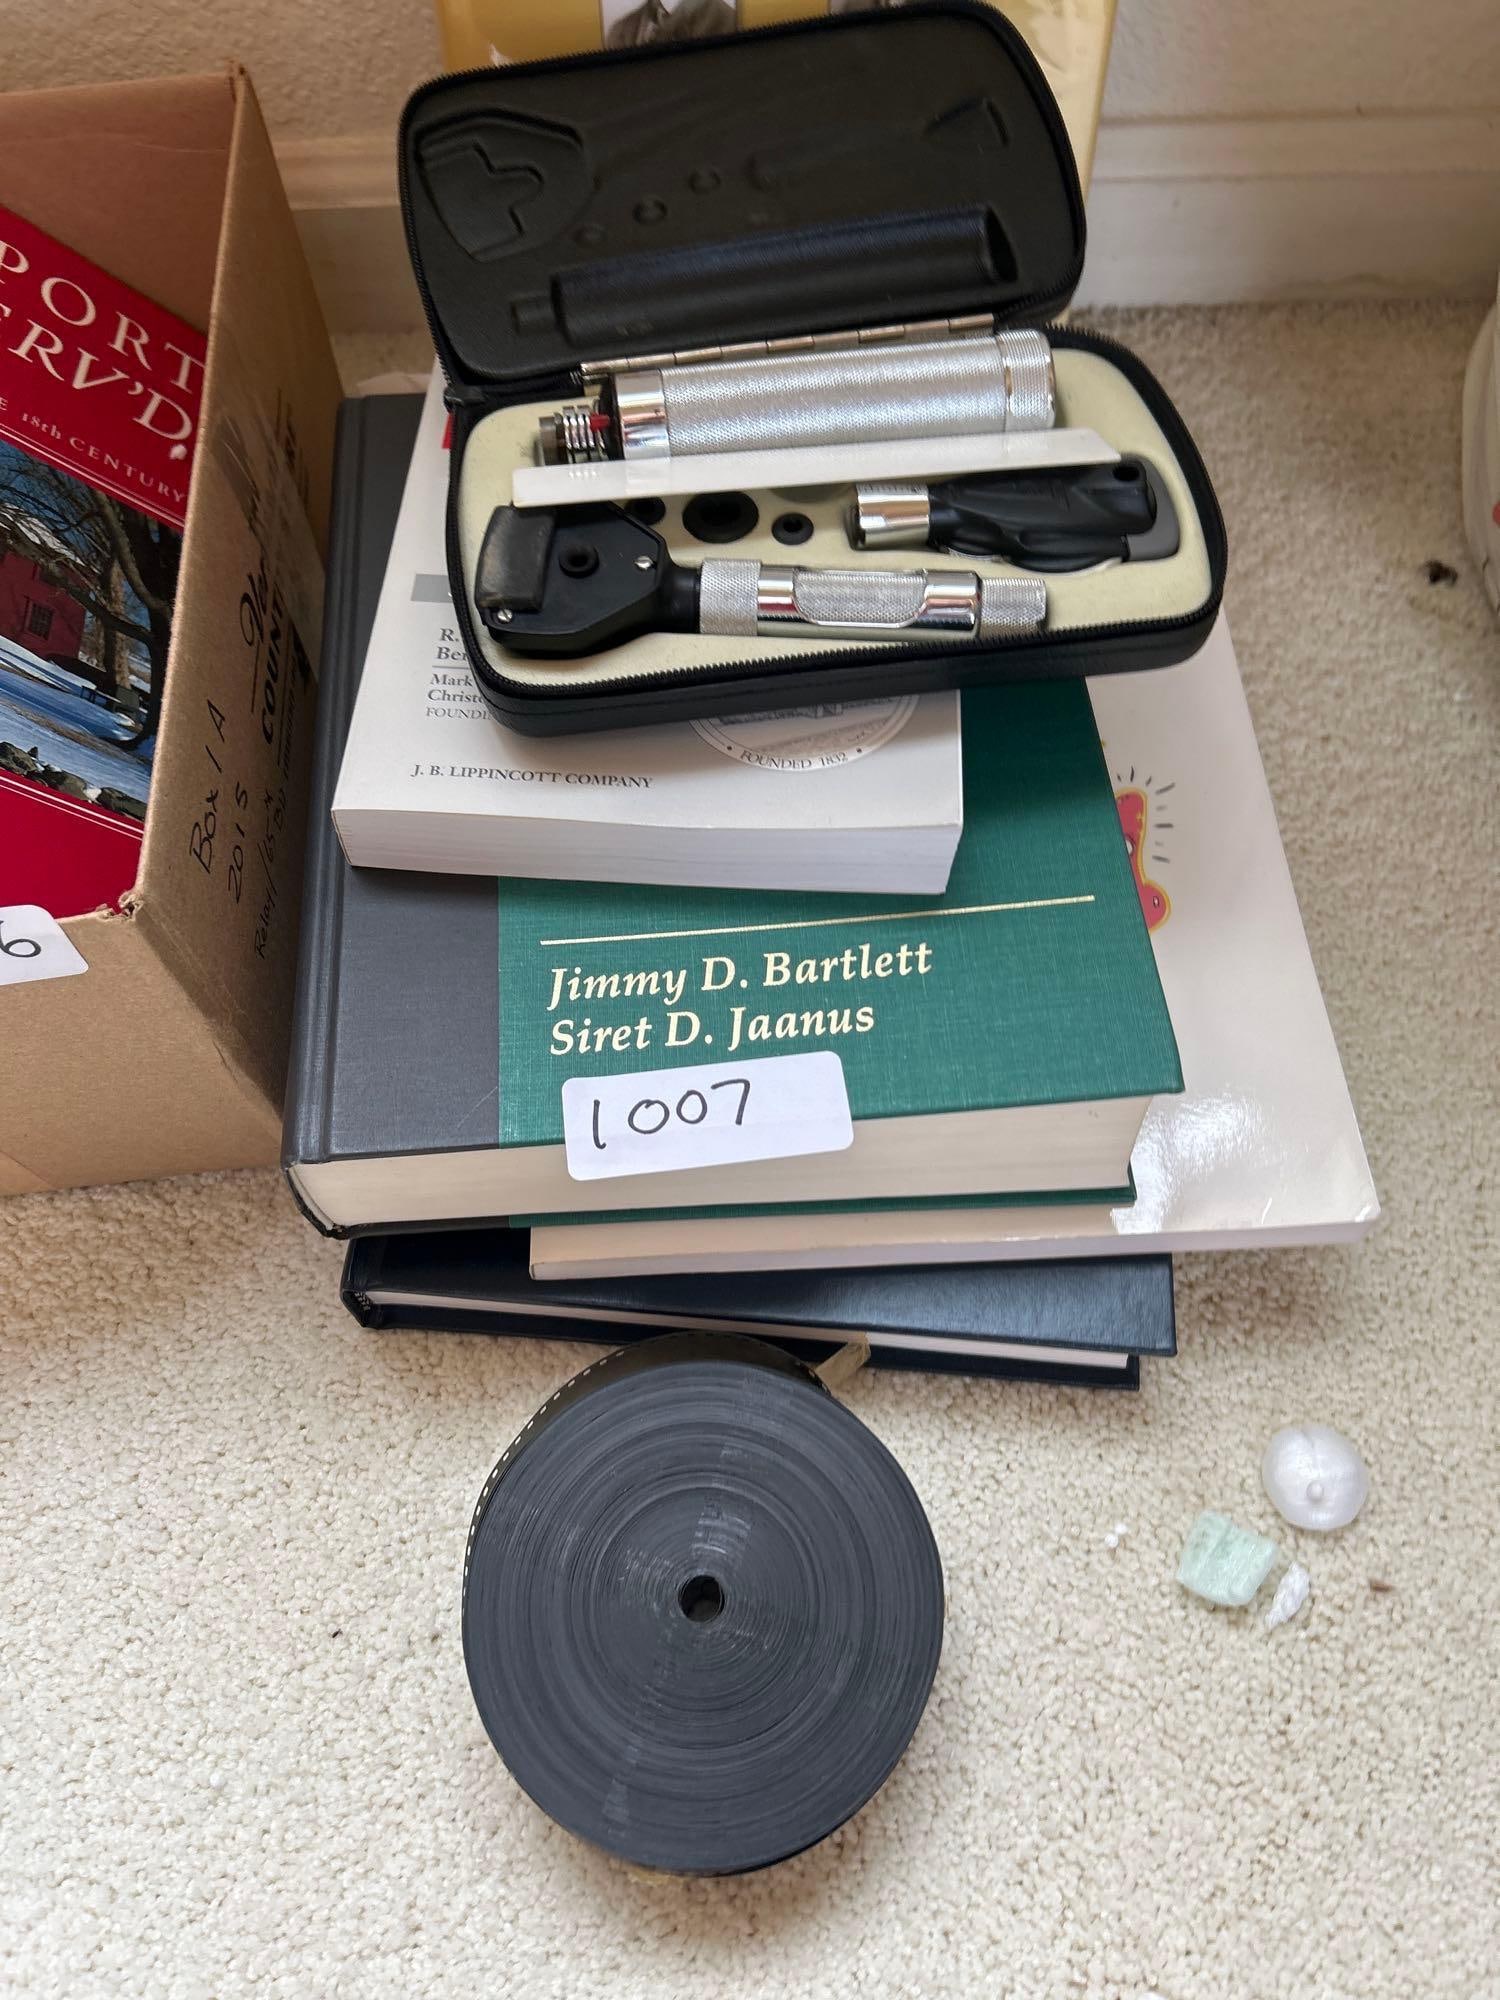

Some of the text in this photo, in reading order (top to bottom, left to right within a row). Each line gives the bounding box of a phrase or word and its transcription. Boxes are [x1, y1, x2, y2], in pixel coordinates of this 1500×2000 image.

[0, 303, 193, 460] RV'D.
[69, 437, 188, 503] CENTURY
[439, 628, 459, 642] R.
[430, 673, 473, 687] Mark
[189, 788, 219, 873] Box
[207, 699, 226, 743] A
[411, 764, 653, 788] J. B. LIPPINCOTT COMPANY
[739, 750, 812, 769] FOUNDED
[227, 781, 248, 904] 2015
[546, 941, 934, 1011] Jimmy D. Bartlett
[549, 1004, 875, 1056] Siret D. Jaanus
[591, 1077, 751, 1150] 1007
